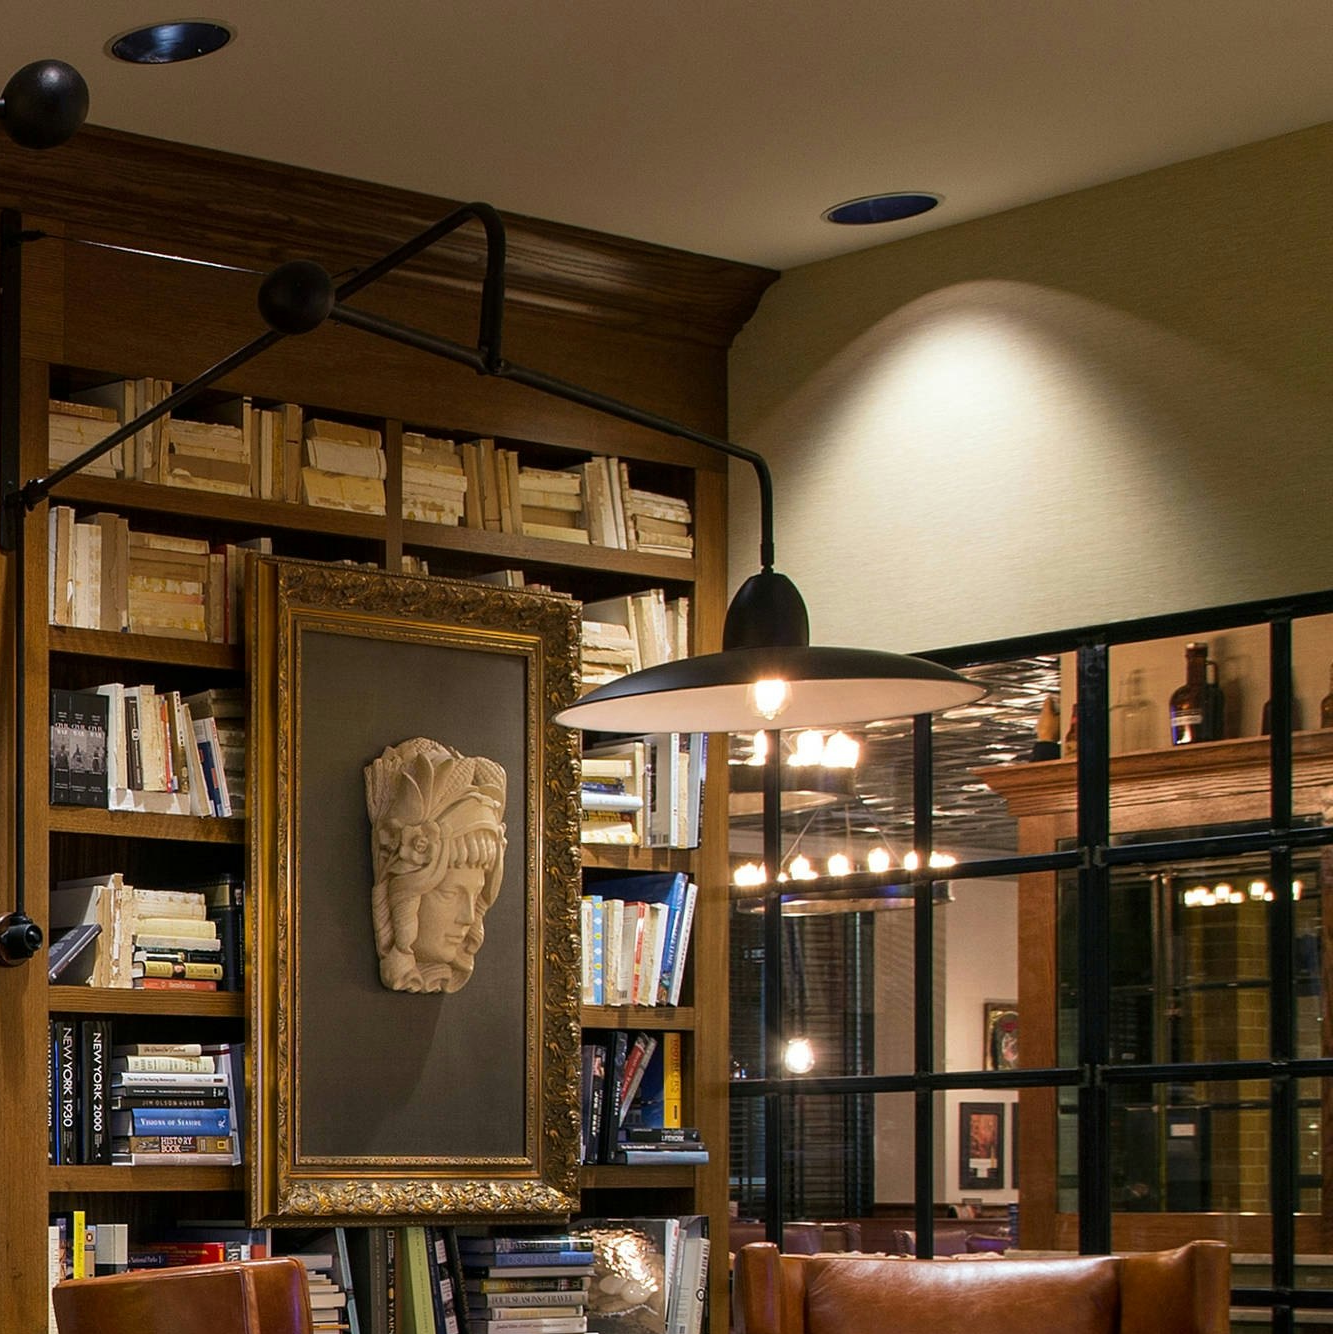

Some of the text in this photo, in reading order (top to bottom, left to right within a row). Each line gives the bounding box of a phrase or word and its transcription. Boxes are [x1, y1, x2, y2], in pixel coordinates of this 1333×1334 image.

[62, 1028, 72, 1126] NEW YORK 1930
[92, 1033, 101, 1130] NEW YORK 2000
